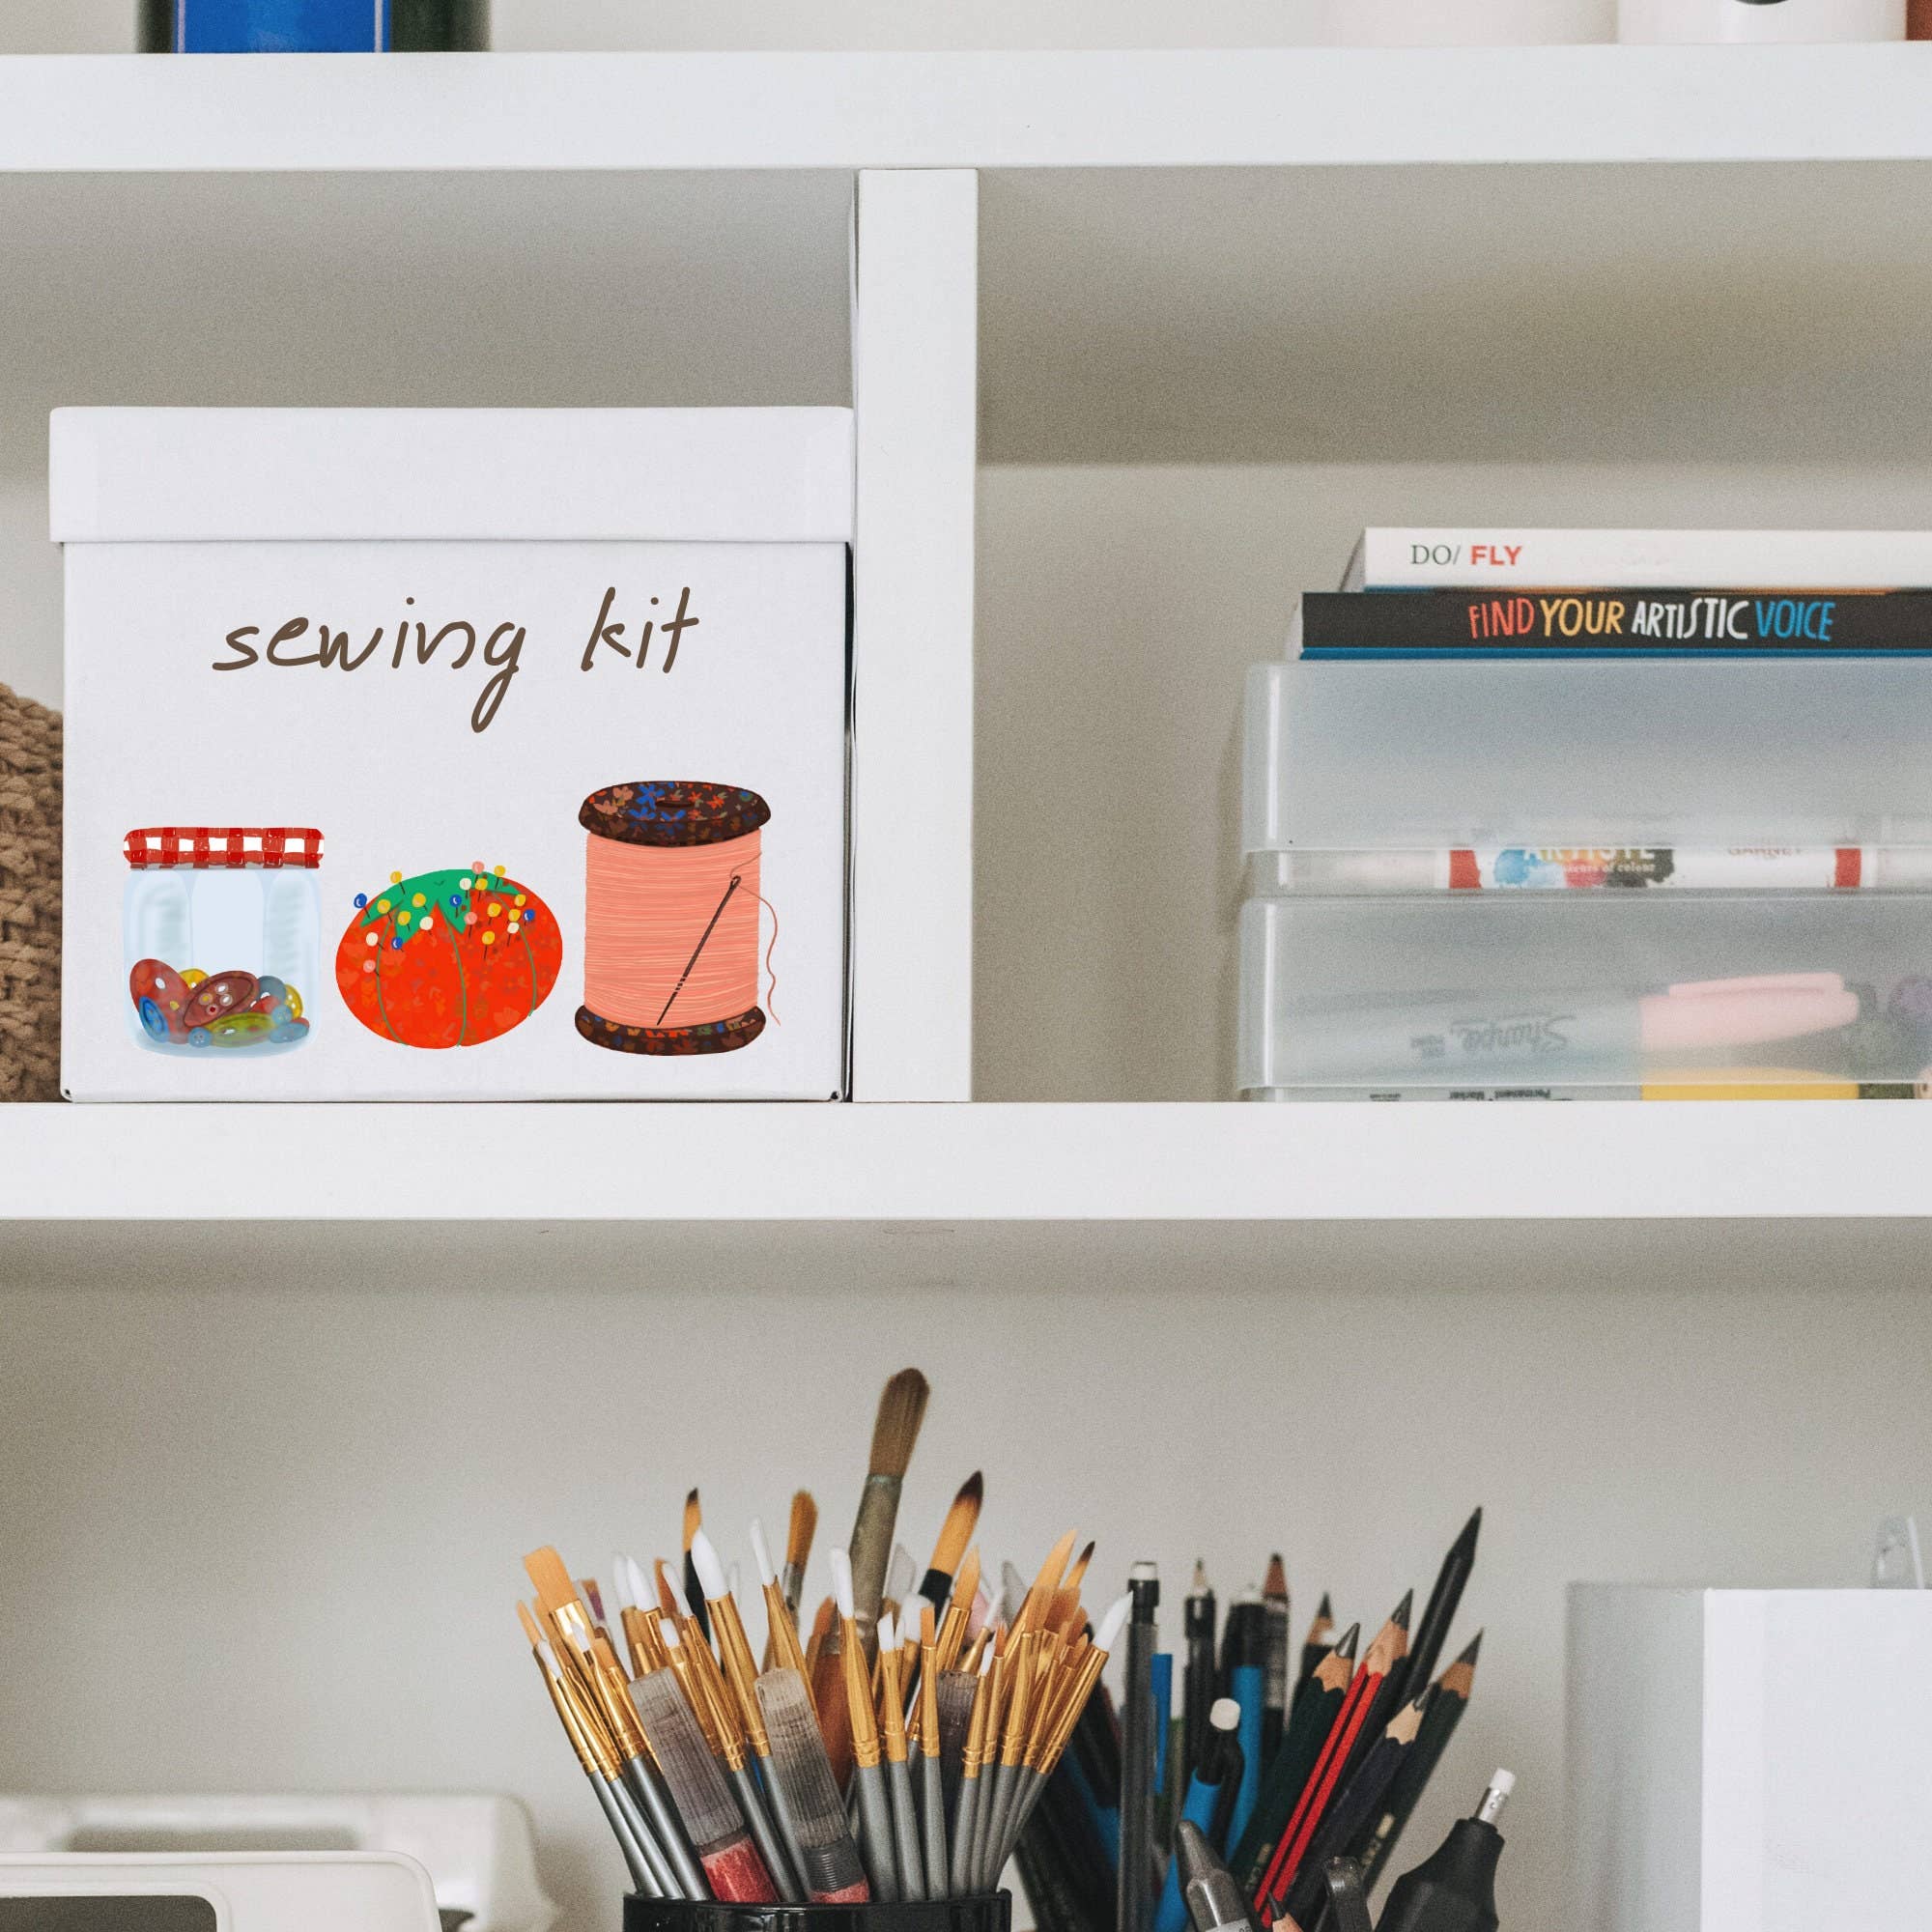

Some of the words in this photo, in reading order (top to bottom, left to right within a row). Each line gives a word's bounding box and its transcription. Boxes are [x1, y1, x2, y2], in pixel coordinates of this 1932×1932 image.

[1409, 544, 1462, 566] DO/
[1471, 545, 1523, 566] FLY
[1468, 598, 1535, 639] FIND
[1539, 598, 1626, 637] YOUR
[1631, 597, 1750, 640] ARTISTIC
[1754, 599, 1836, 642] VOICE
[212, 596, 526, 733] sewing
[581, 586, 700, 674] kit
